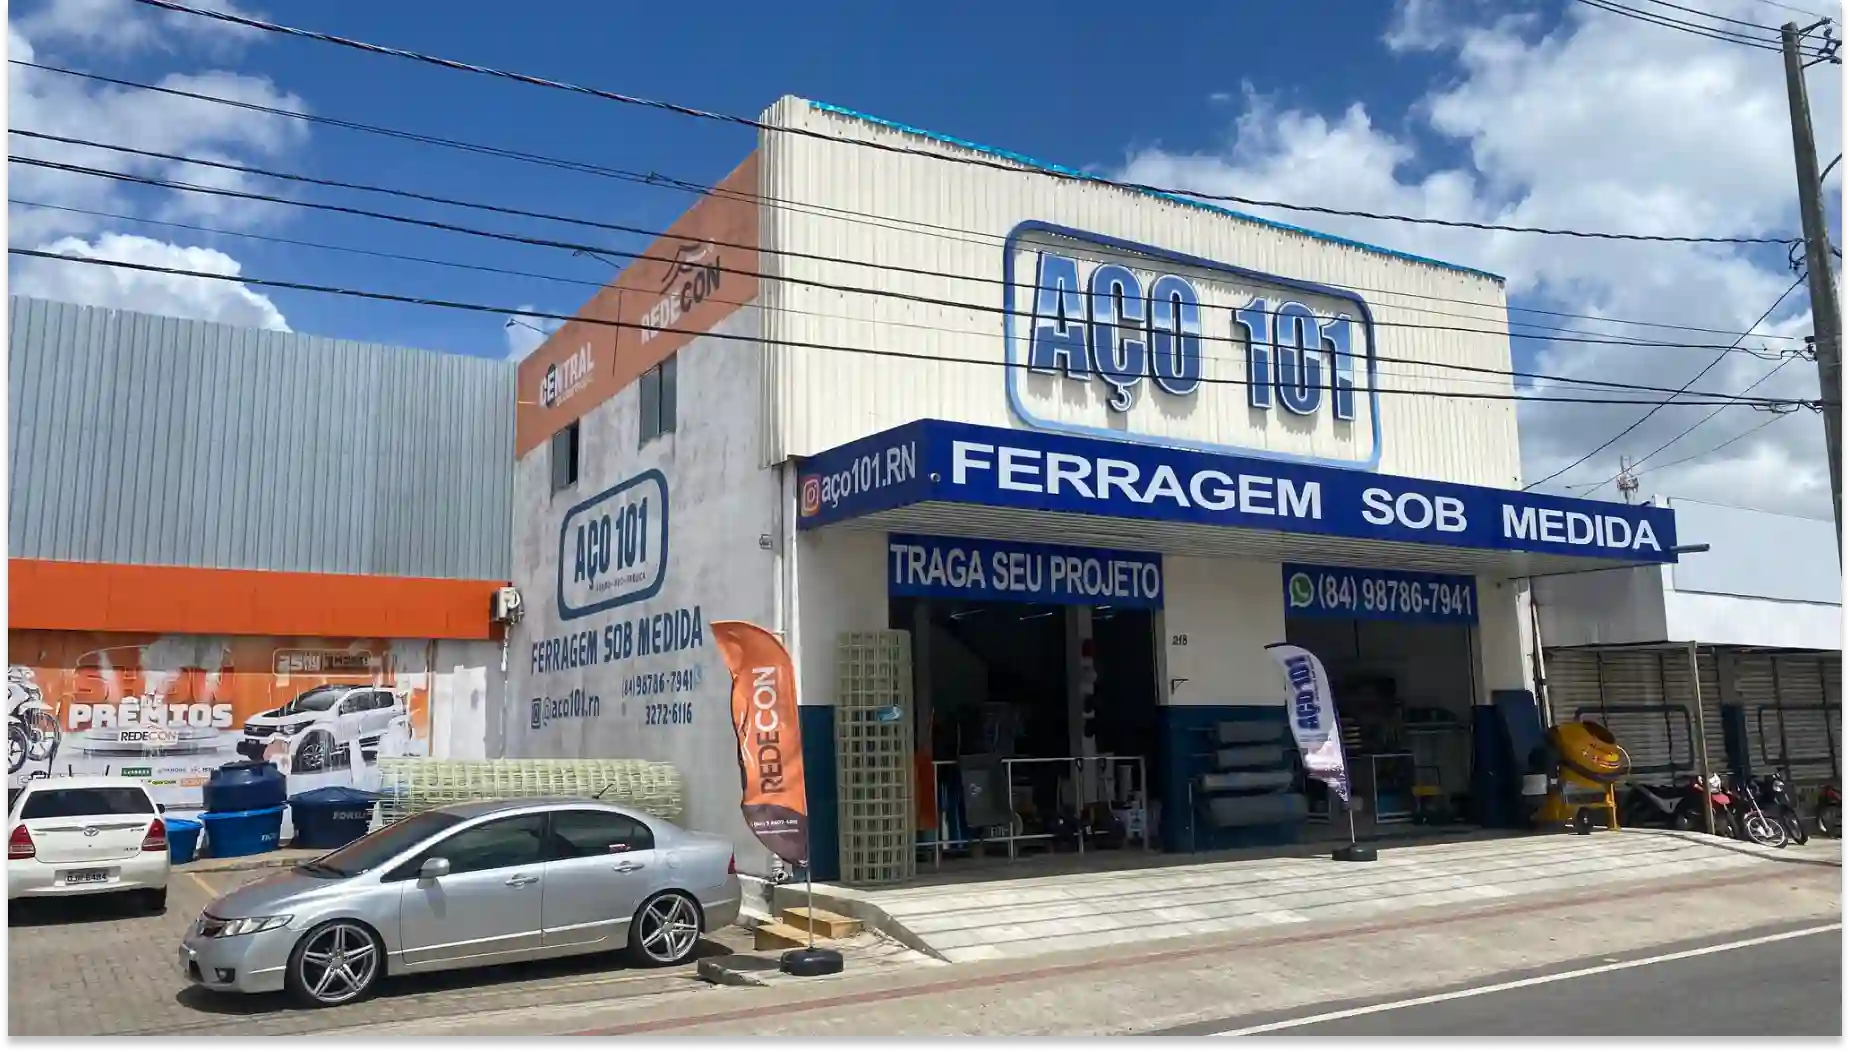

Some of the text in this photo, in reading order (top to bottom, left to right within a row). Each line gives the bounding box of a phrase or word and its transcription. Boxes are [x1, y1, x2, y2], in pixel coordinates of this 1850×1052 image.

[641, 256, 721, 345] REDECON
[1028, 251, 1355, 420] AÇO 101
[539, 342, 595, 408] CENTRAL
[821, 441, 915, 508] aço101.RN
[952, 440, 1661, 551] FERRAGEM SOB MEDIDA
[574, 497, 648, 591] AÇO 101
[890, 544, 1160, 599] TRAGA SEU PROJETO
[1318, 576, 1472, 617] (84) 98786-7941
[531, 605, 703, 675] FERRAGEM SOB MEDIDA
[1171, 634, 1188, 646] 218
[68, 696, 233, 729] PRÊMIOS
[121, 731, 177, 742] REDECON
[751, 666, 785, 794] REDECON
